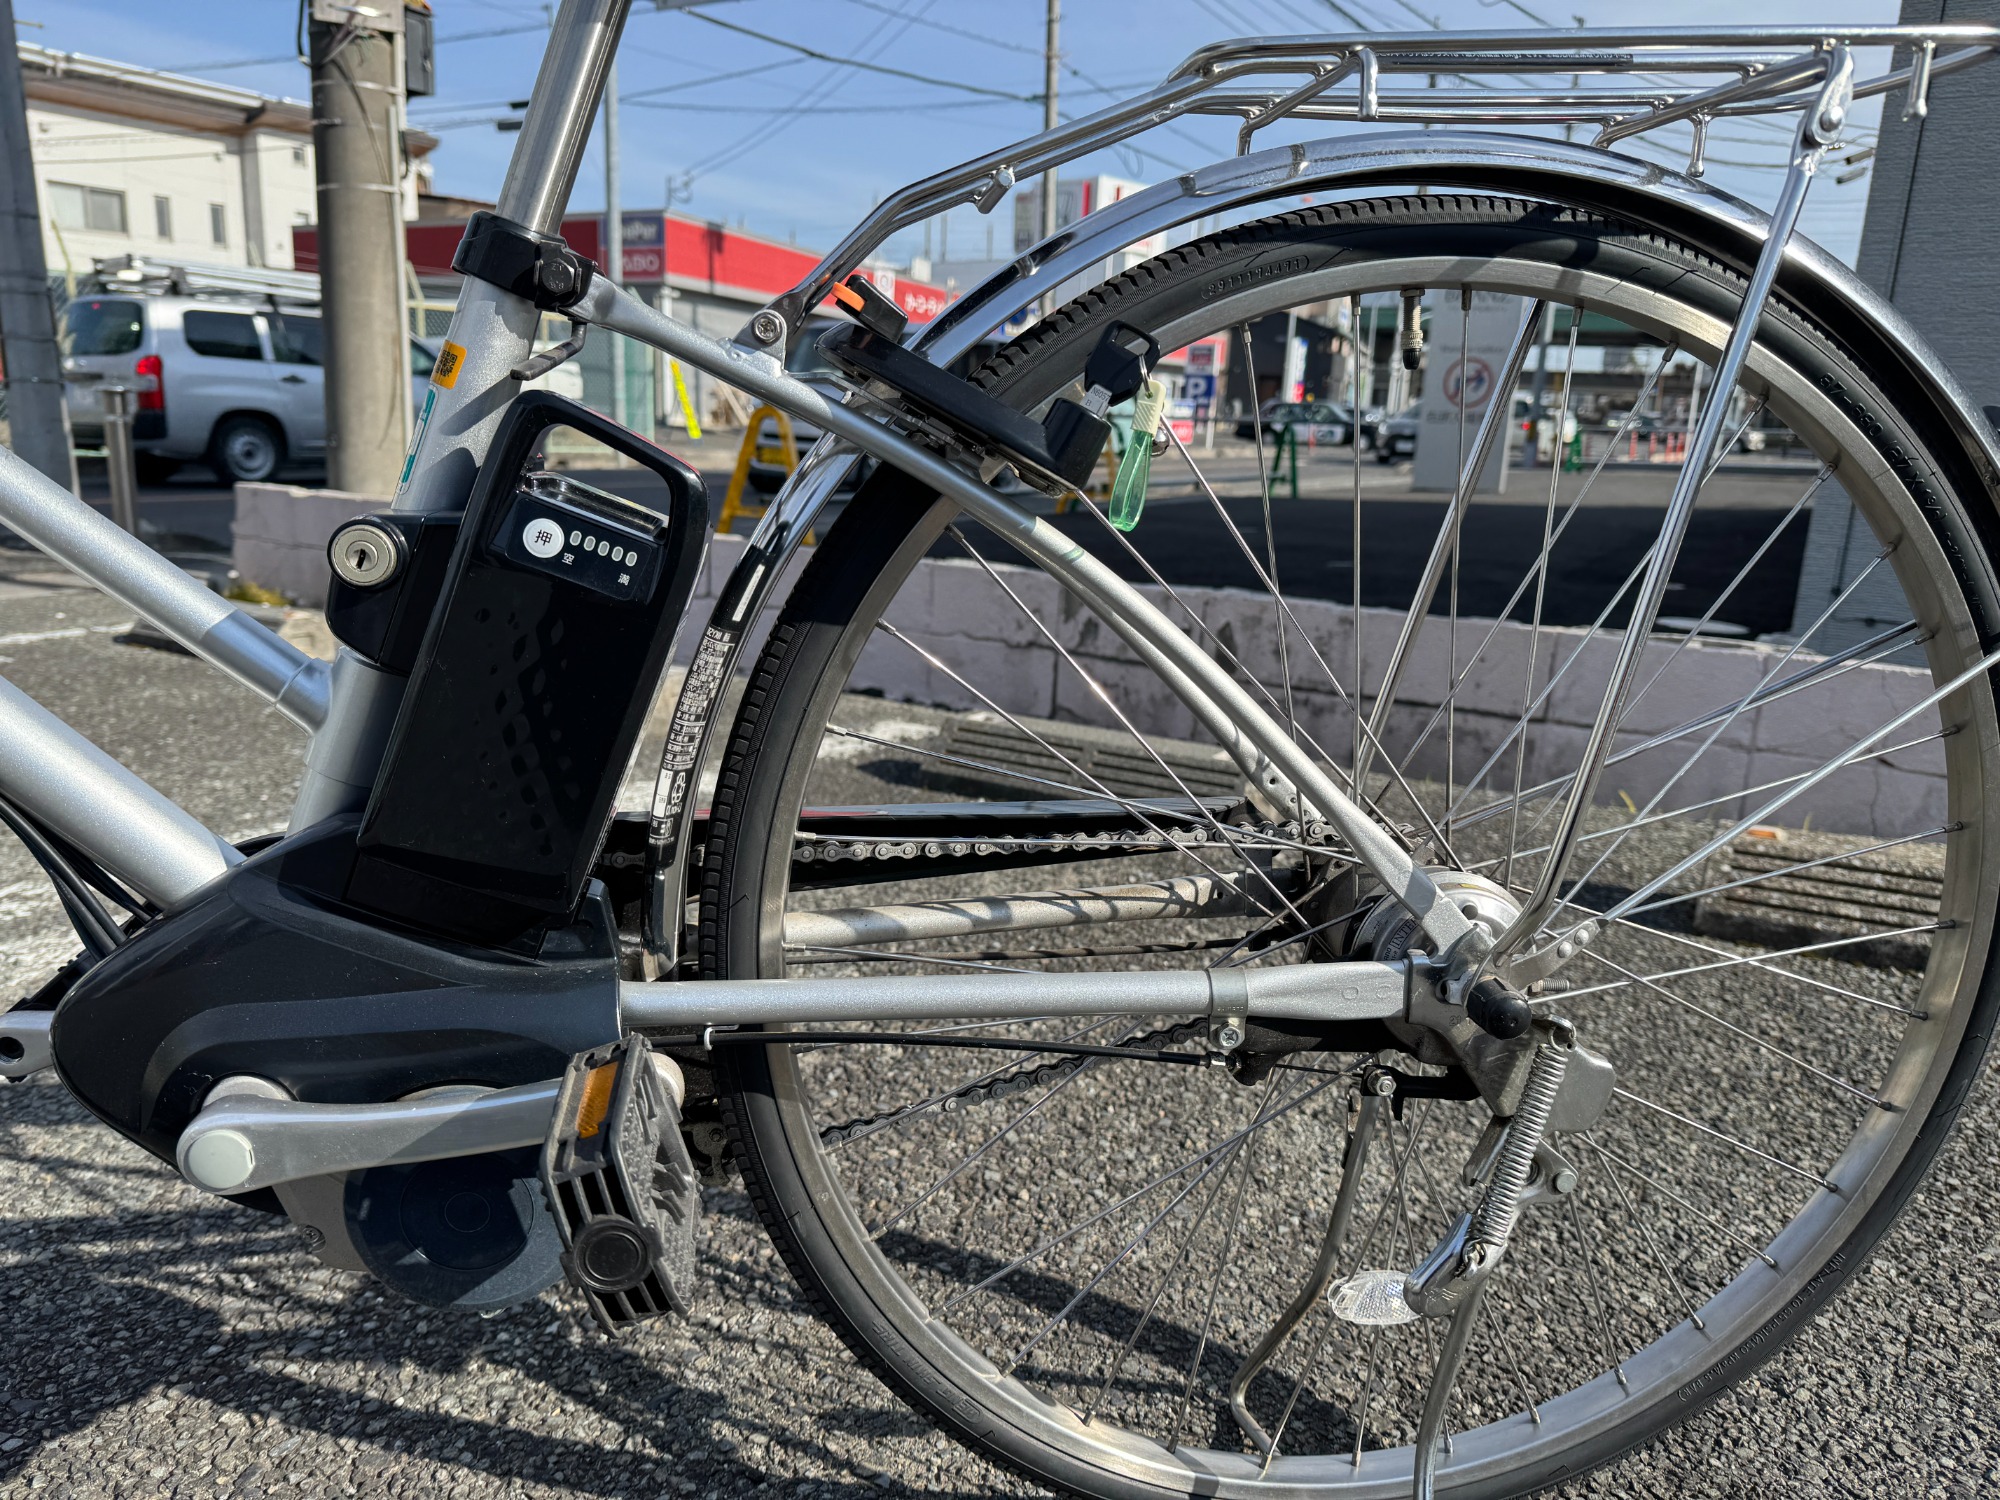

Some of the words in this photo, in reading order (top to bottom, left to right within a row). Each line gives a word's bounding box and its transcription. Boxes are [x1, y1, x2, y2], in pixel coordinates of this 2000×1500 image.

[534, 529, 553, 547] 押
[561, 552, 575, 566] 空
[617, 572, 631, 586] 満
